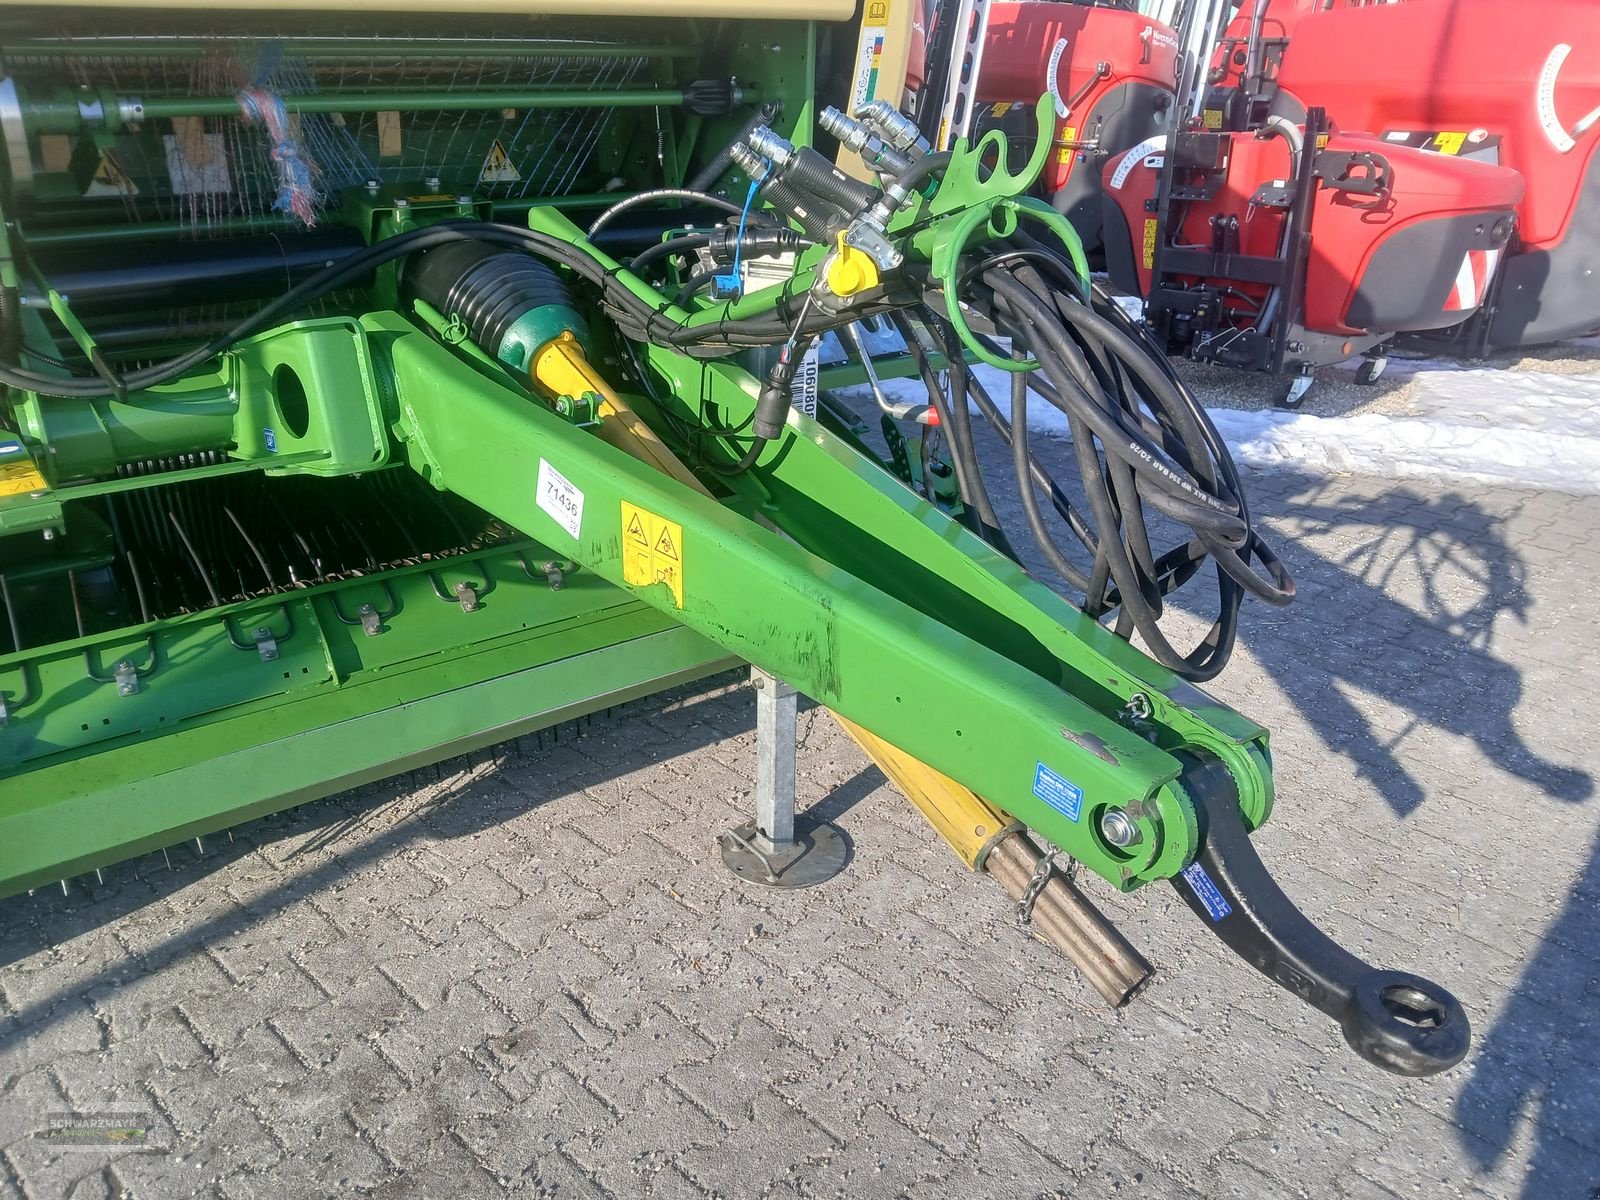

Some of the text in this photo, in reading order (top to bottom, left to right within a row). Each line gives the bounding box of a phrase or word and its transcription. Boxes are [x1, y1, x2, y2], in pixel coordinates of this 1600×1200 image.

[1129, 442, 1152, 462] 2Q/20
[1152, 460, 1169, 476] BAR
[1168, 472, 1182, 485] 330
[1181, 481, 1192, 492] WP
[546, 481, 578, 517] 71436
